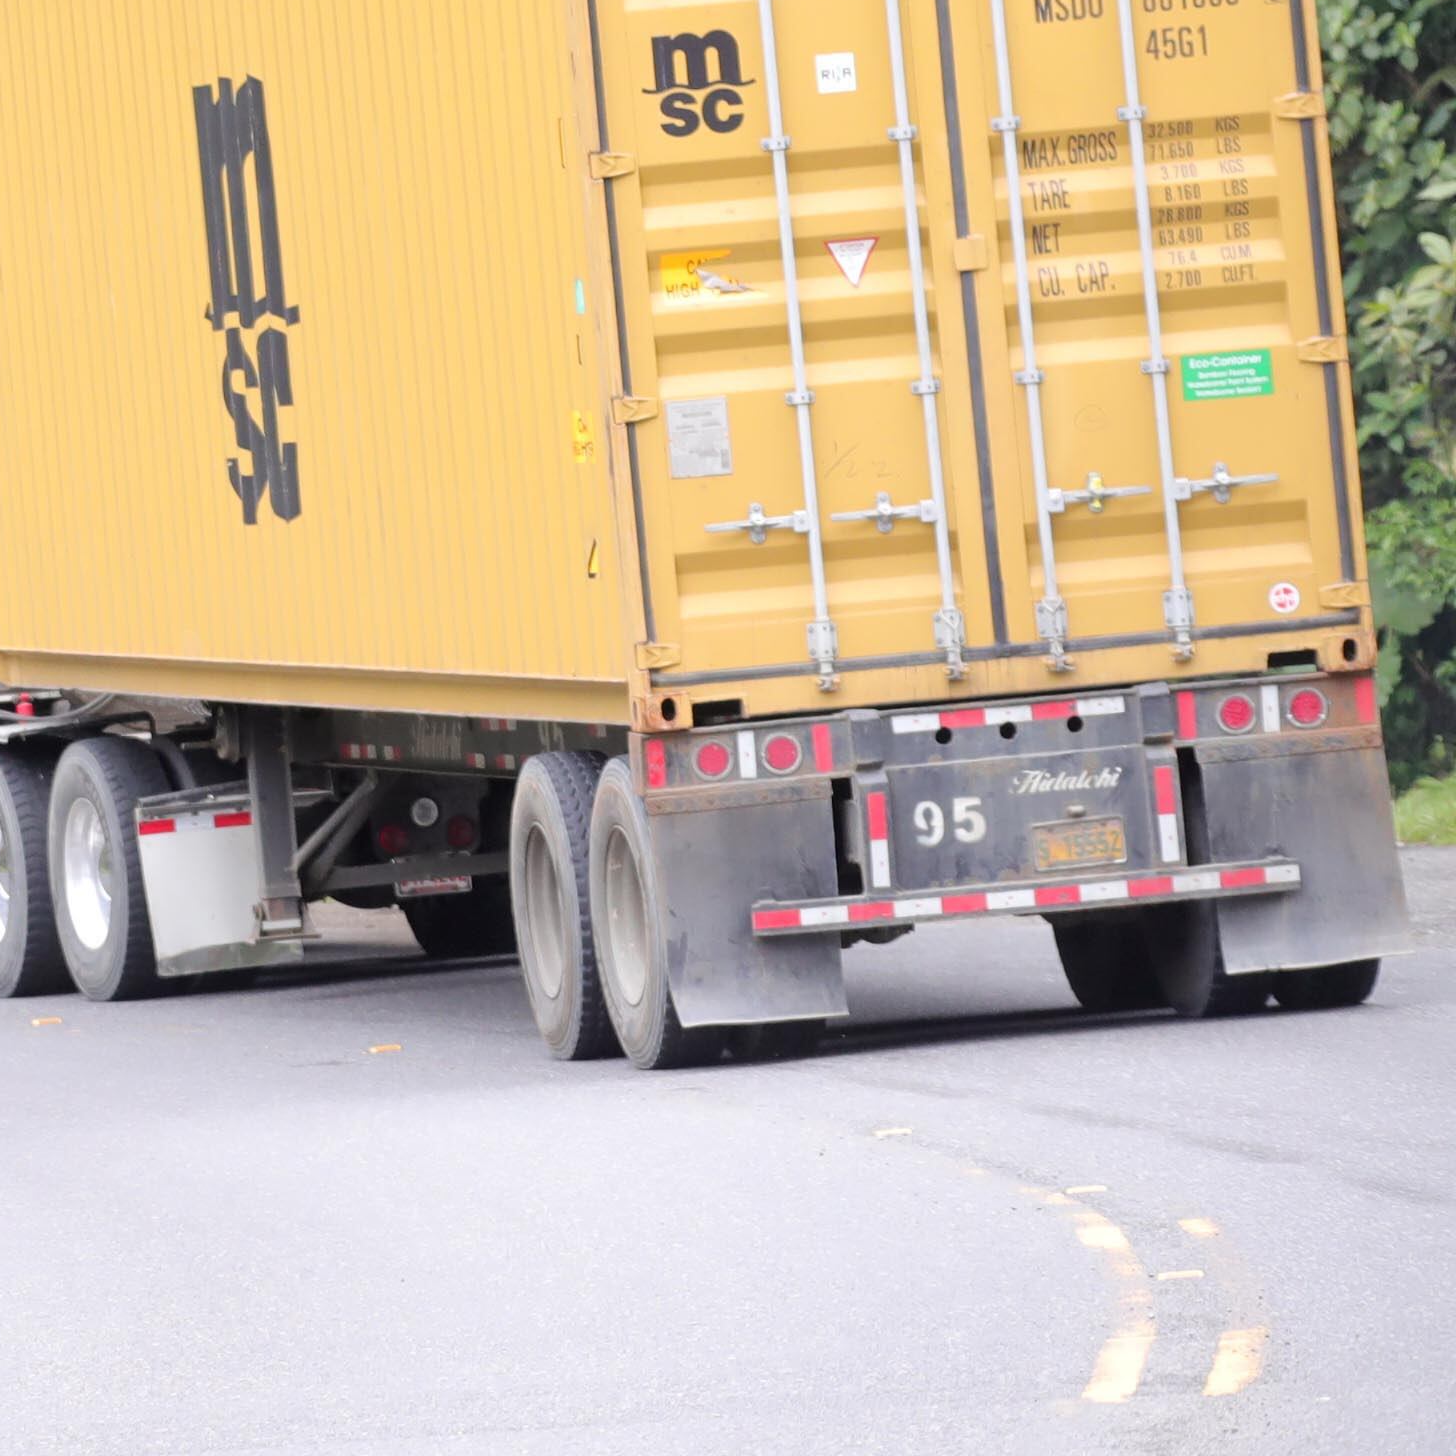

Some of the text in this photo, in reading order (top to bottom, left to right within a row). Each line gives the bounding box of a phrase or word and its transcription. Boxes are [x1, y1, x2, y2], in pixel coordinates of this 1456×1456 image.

[1145, 25, 1209, 60] 45G1
[1147, 120, 1194, 139] 32.500
[1215, 116, 1240, 133] KGS
[1216, 136, 1242, 155] LBS
[1027, 179, 1072, 212] TARE
[1219, 159, 1246, 176] KGS
[1222, 178, 1249, 198] LBS
[1032, 222, 1062, 255] NET
[1224, 201, 1250, 218] KGS
[1225, 221, 1251, 240] LBS
[1038, 266, 1066, 297] CU.
[1075, 261, 1117, 294] CAP.
[1165, 270, 1202, 290] 2.700
[913, 795, 988, 848] 95
